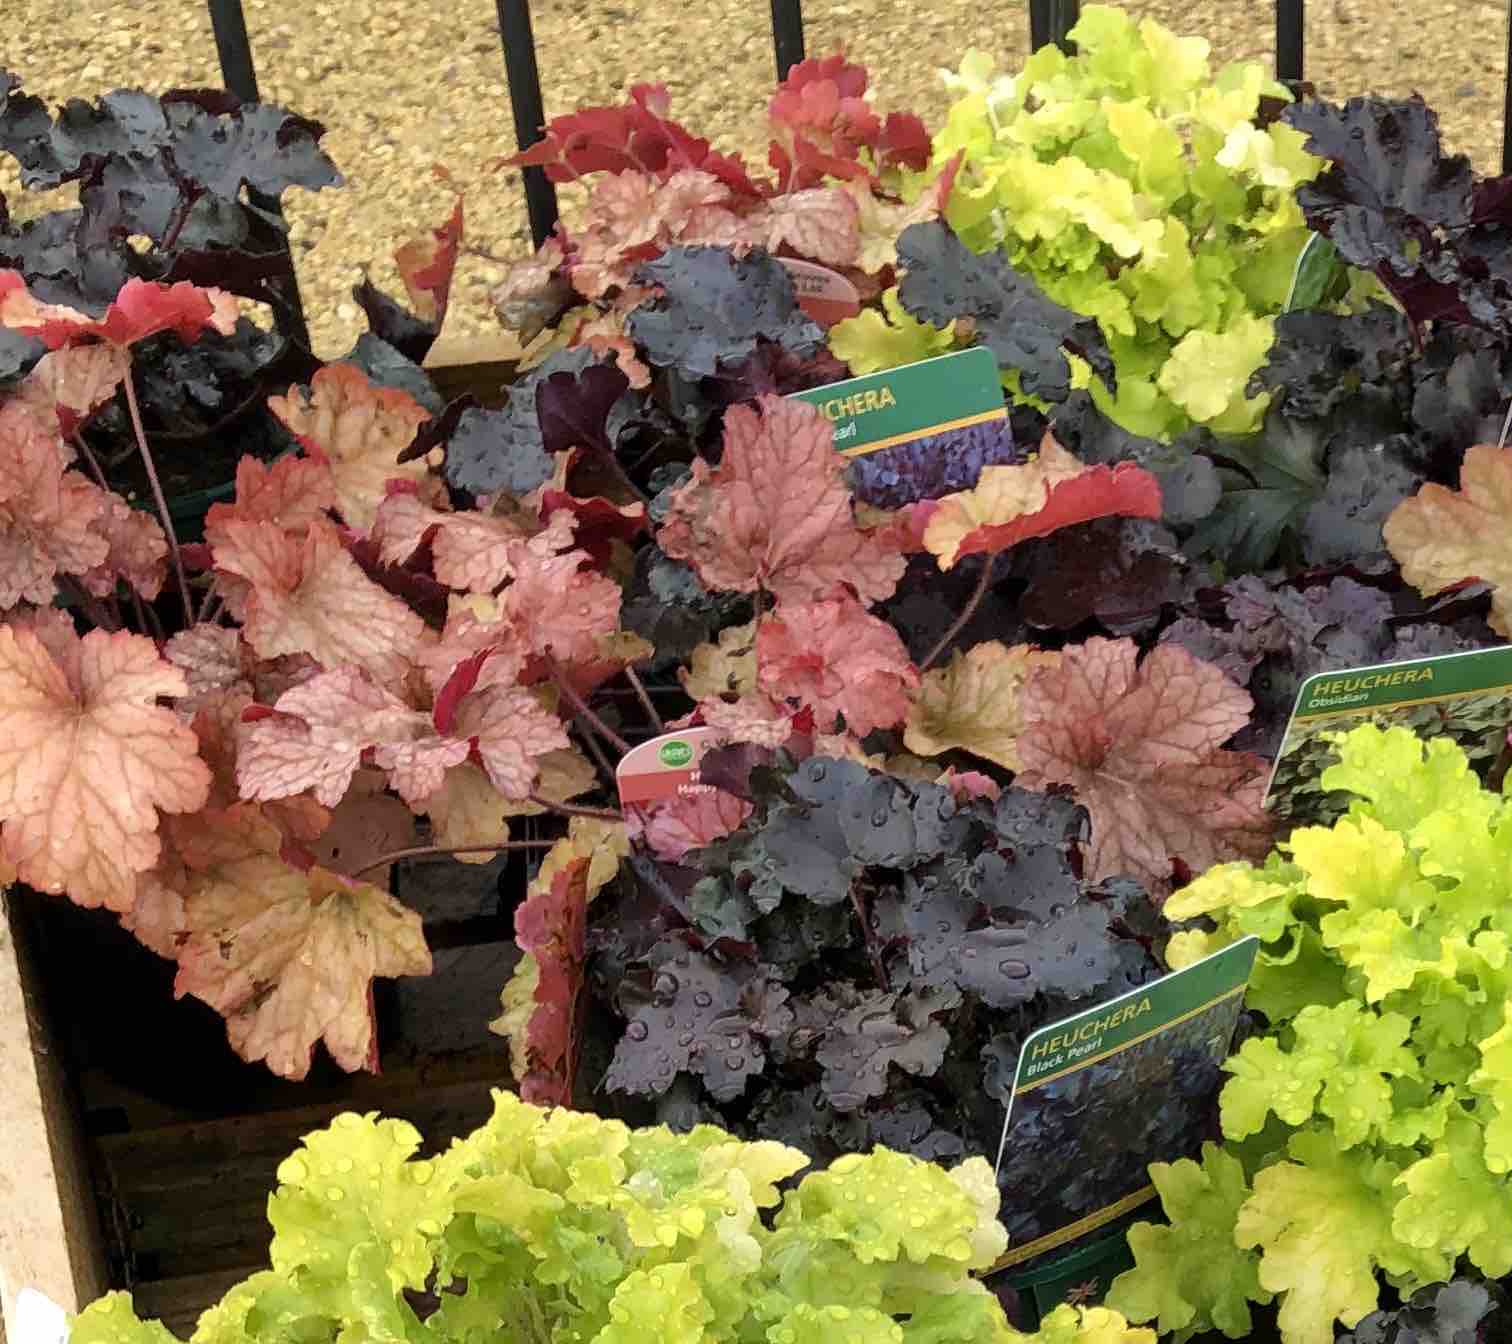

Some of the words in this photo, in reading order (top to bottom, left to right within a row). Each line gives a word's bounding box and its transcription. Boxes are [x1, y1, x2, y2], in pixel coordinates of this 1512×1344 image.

[817, 386, 897, 421] CHERA
[833, 421, 857, 441] earl
[1311, 667, 1434, 698] HEUCHERA
[1307, 691, 1370, 709] Obsidian
[1031, 997, 1153, 1060] HEUCHERA
[1026, 1053, 1065, 1077] Black
[1067, 1037, 1103, 1060] Pearl
